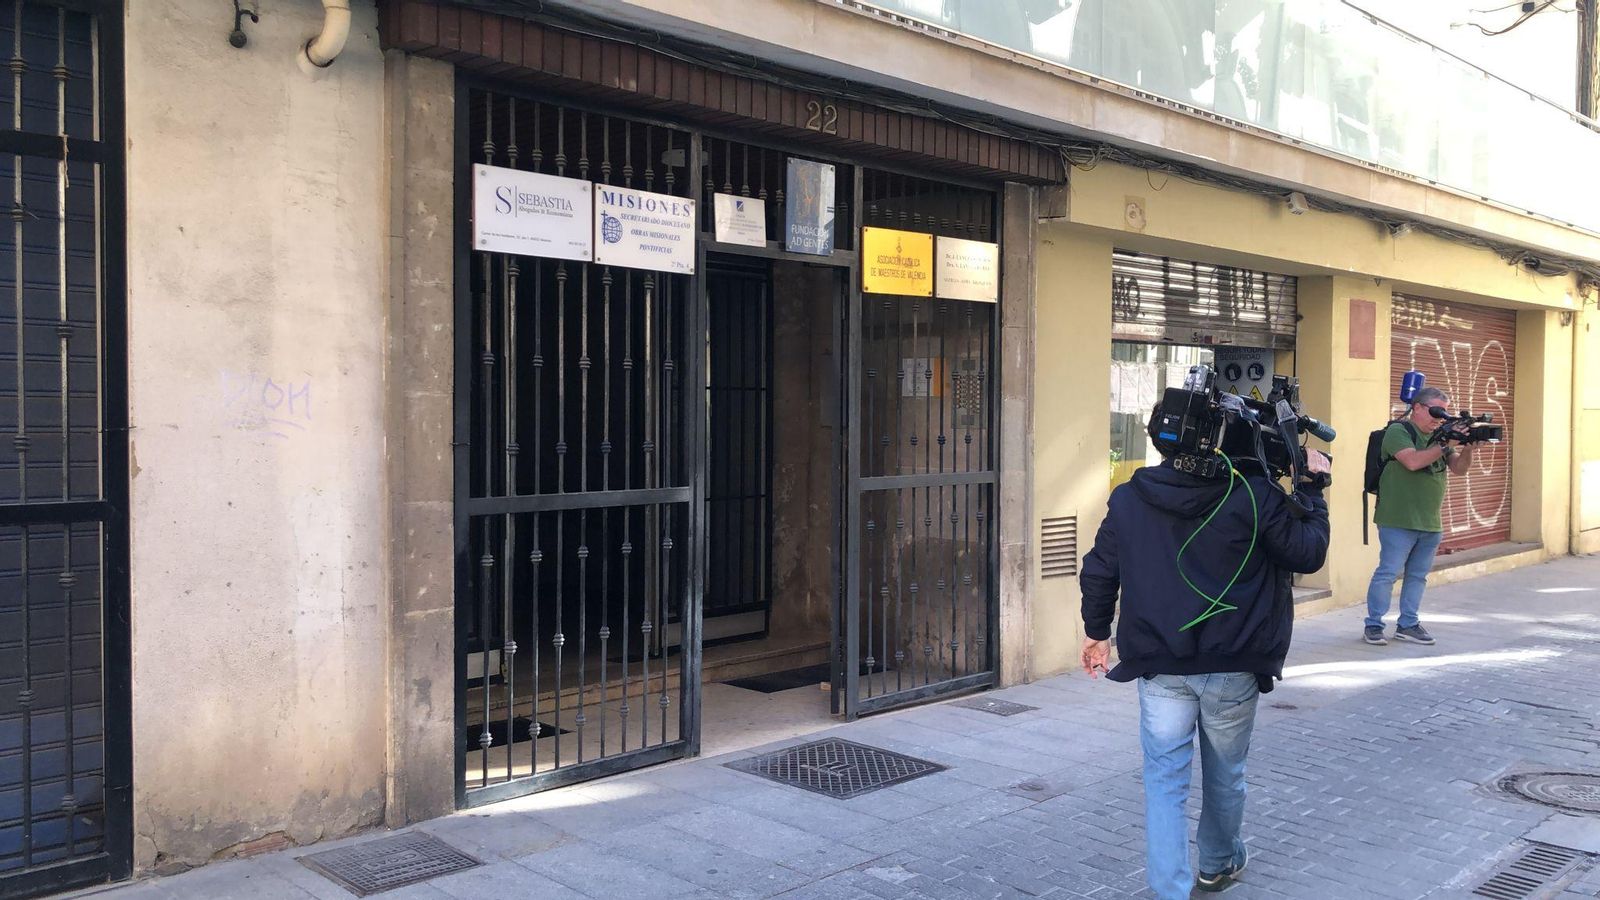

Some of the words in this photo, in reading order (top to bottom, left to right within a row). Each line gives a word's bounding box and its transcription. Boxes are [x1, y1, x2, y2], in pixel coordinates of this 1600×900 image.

[805, 100, 838, 135] 22
[495, 185, 512, 215] S
[602, 190, 690, 217] MISIONES
[620, 213, 660, 224] SECRETARIADO
[661, 219, 690, 228] DIOCESANO
[630, 228, 649, 237] OBRAS
[650, 232, 680, 241] MISIONALES
[639, 244, 673, 254] PONTIFICIAS
[791, 236, 803, 246] AD
[804, 238, 829, 250] GENTES
[870, 267, 876, 276] DE
[878, 268, 900, 278] MAESTROS
